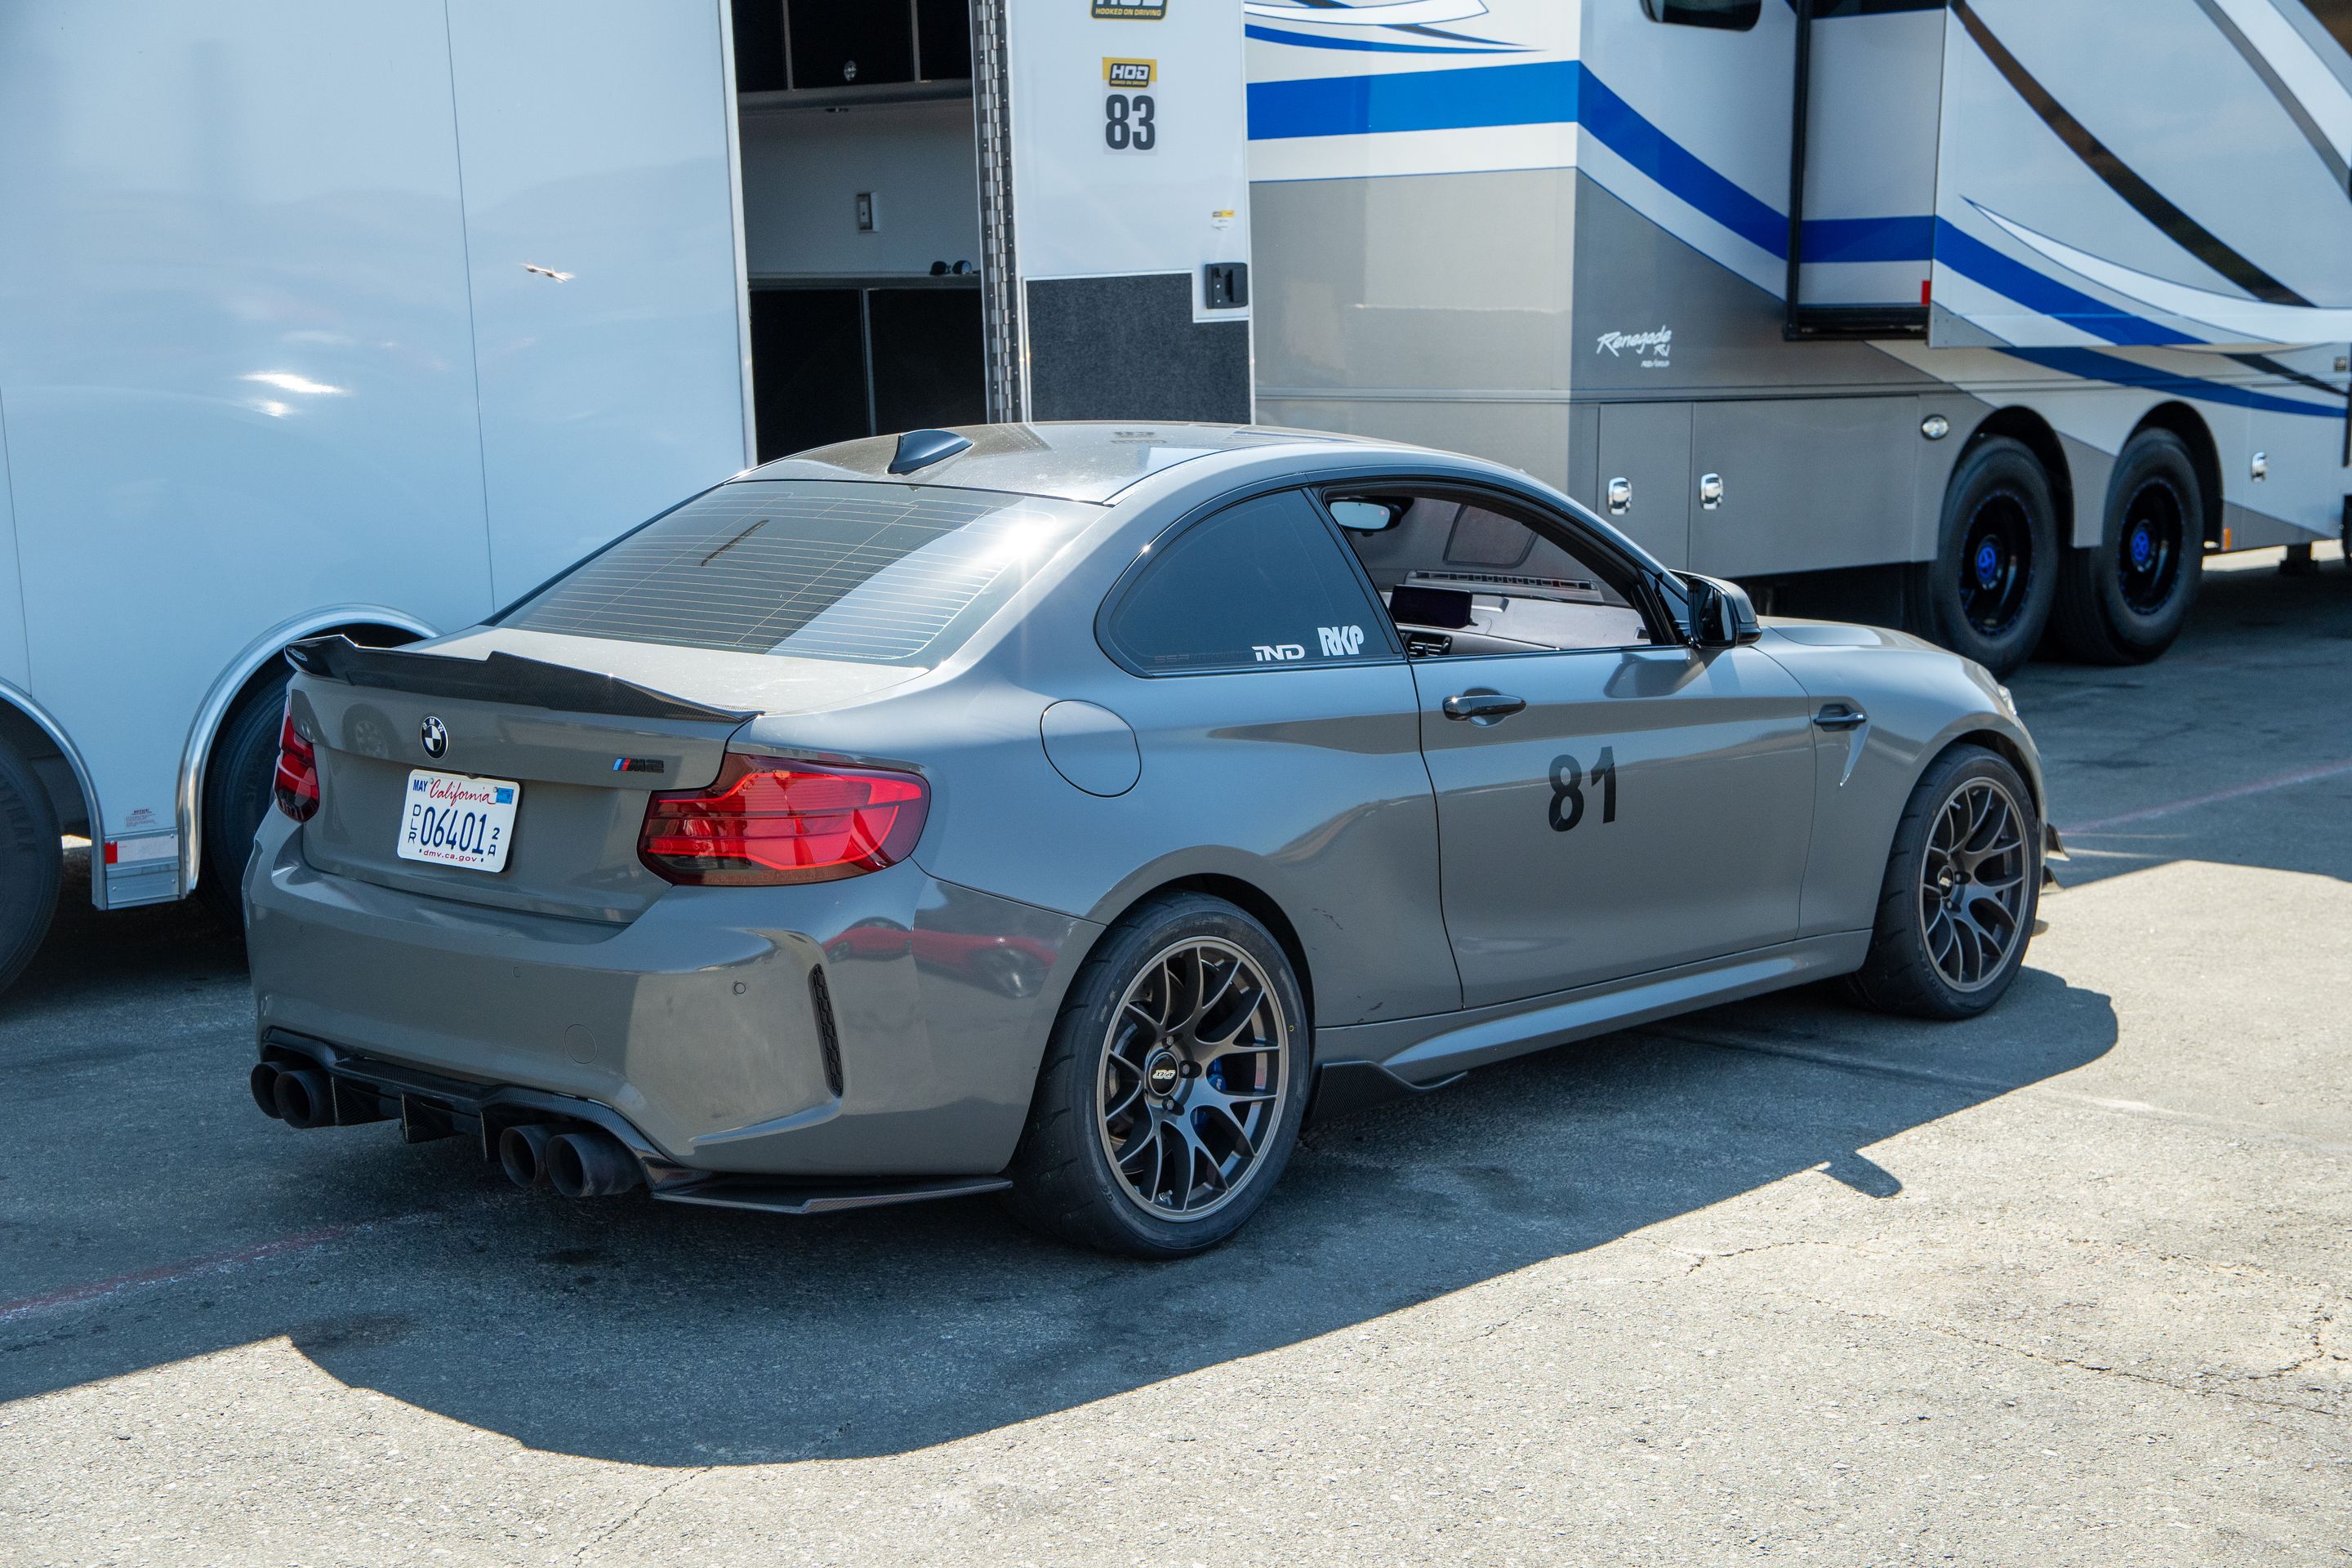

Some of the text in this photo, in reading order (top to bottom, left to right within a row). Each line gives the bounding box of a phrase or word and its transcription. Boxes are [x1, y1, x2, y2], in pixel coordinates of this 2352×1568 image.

[1095, 7, 1123, 16] HOOKED
[1111, 65, 1150, 80] HOD
[1105, 94, 1156, 150] 83
[1596, 324, 1673, 358] Renegade
[1316, 625, 1365, 657] RKP
[422, 717, 444, 733] BMW
[412, 779, 428, 792] MAY
[430, 778, 497, 807] California
[1548, 745, 1617, 832] 81
[420, 806, 488, 855] 06401
[423, 849, 478, 862] dmv.ca.gov
